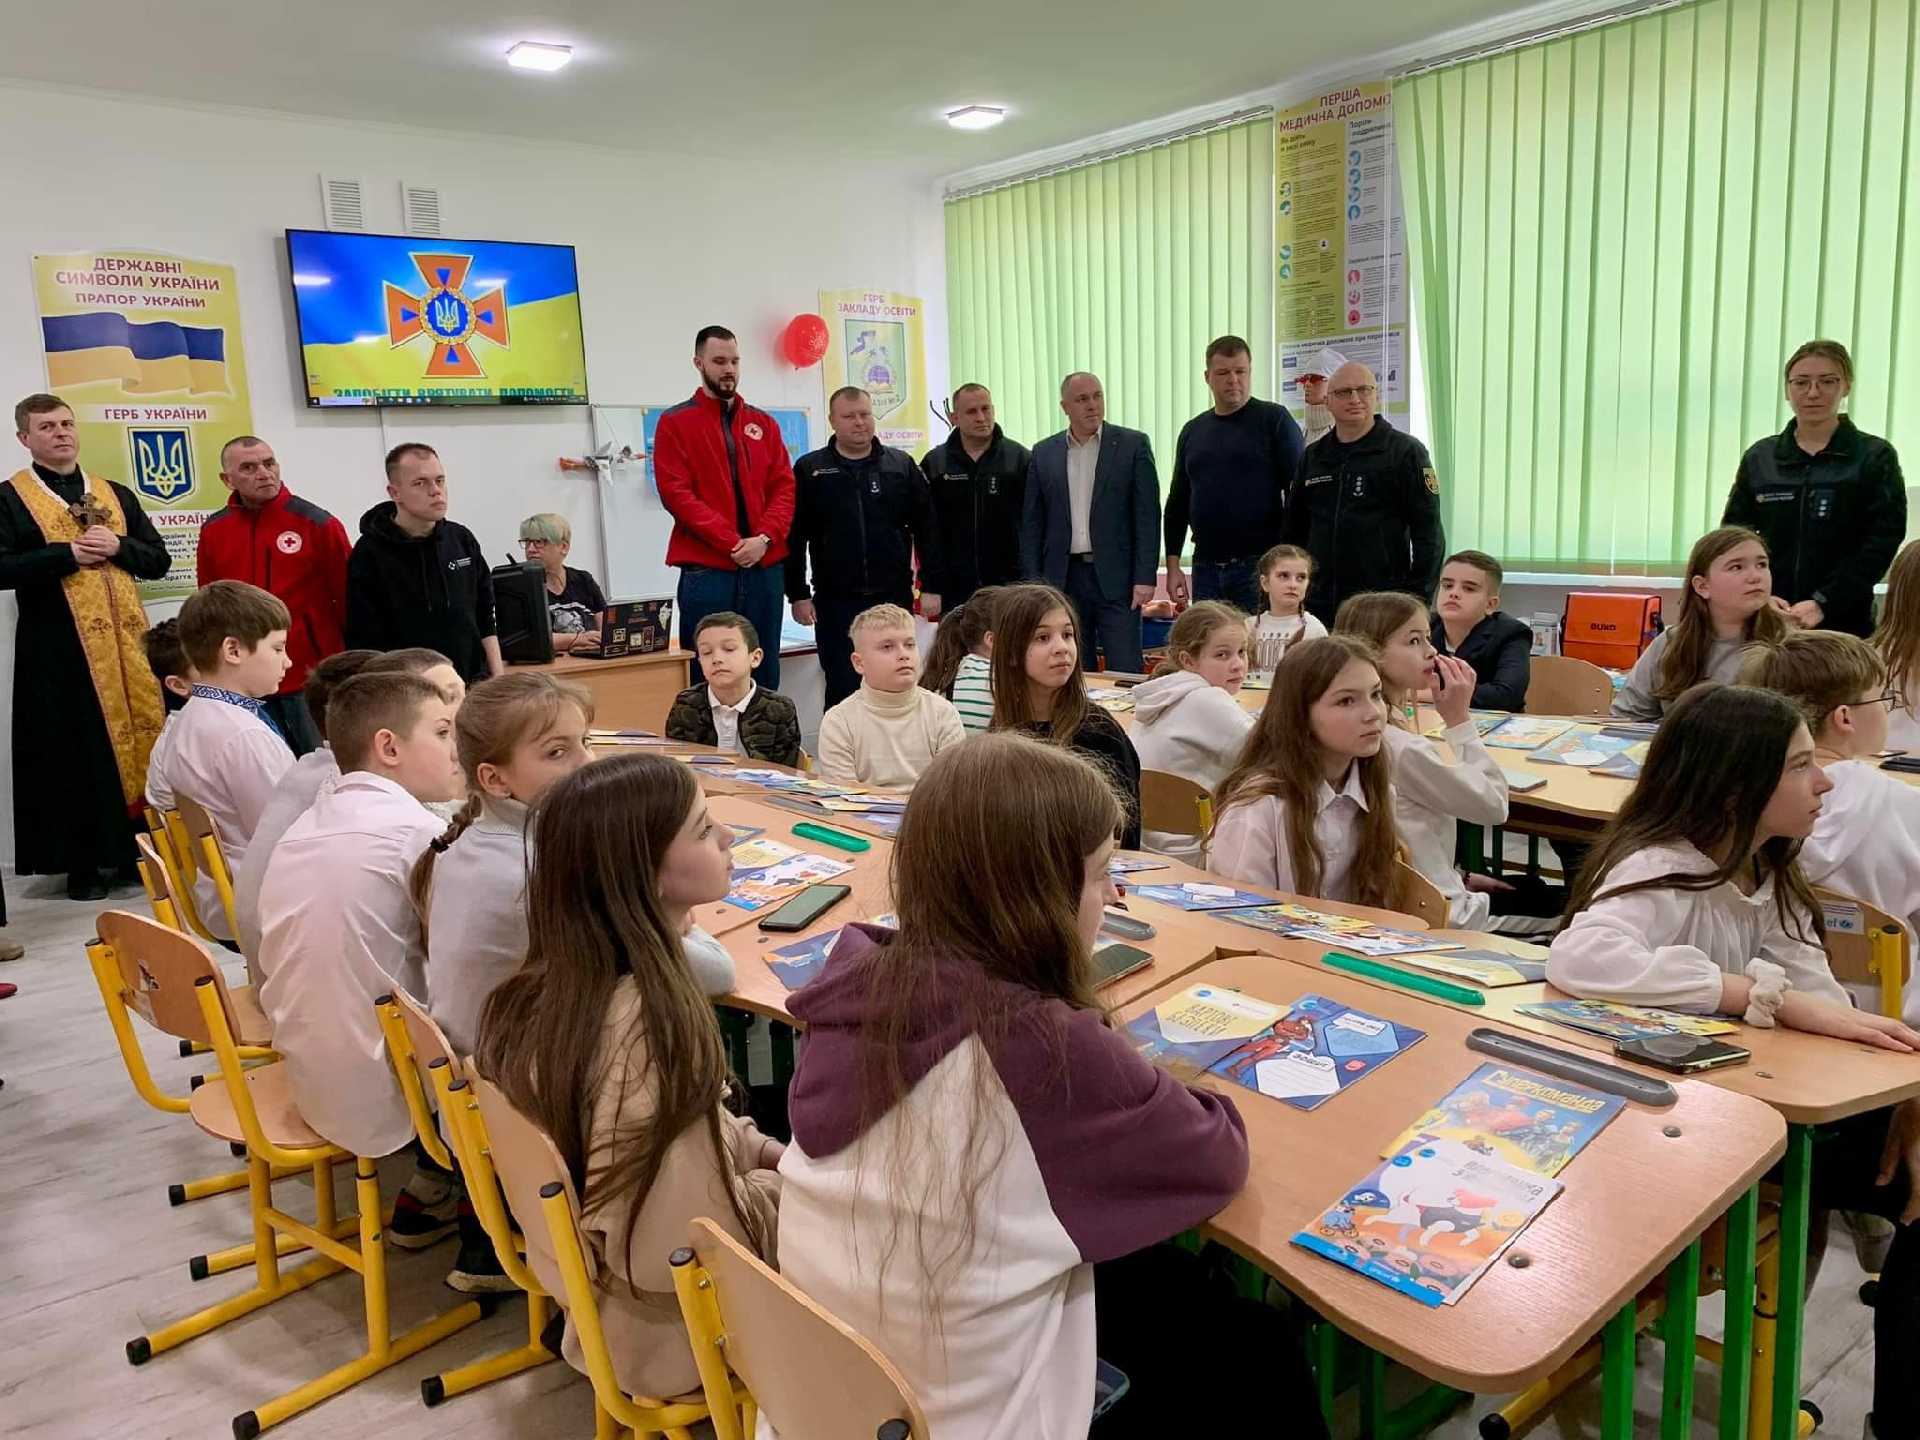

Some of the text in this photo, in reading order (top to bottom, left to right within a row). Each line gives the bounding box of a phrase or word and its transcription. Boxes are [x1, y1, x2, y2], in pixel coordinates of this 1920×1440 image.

[1320, 88, 1361, 107] ПЕРША
[1280, 109, 1334, 132] МЕДИЧНА
[94, 258, 181, 273] ДЕРЖАВНІ
[56, 271, 219, 291] СИМВОЛИ УКРАЇНИ
[75, 293, 206, 308] ПРАПОР УКРАЇНИ
[839, 303, 916, 316] ЗАКЛАДУ ОСВІТИ
[105, 407, 207, 420] ГЕРБ УКРАЇНИ
